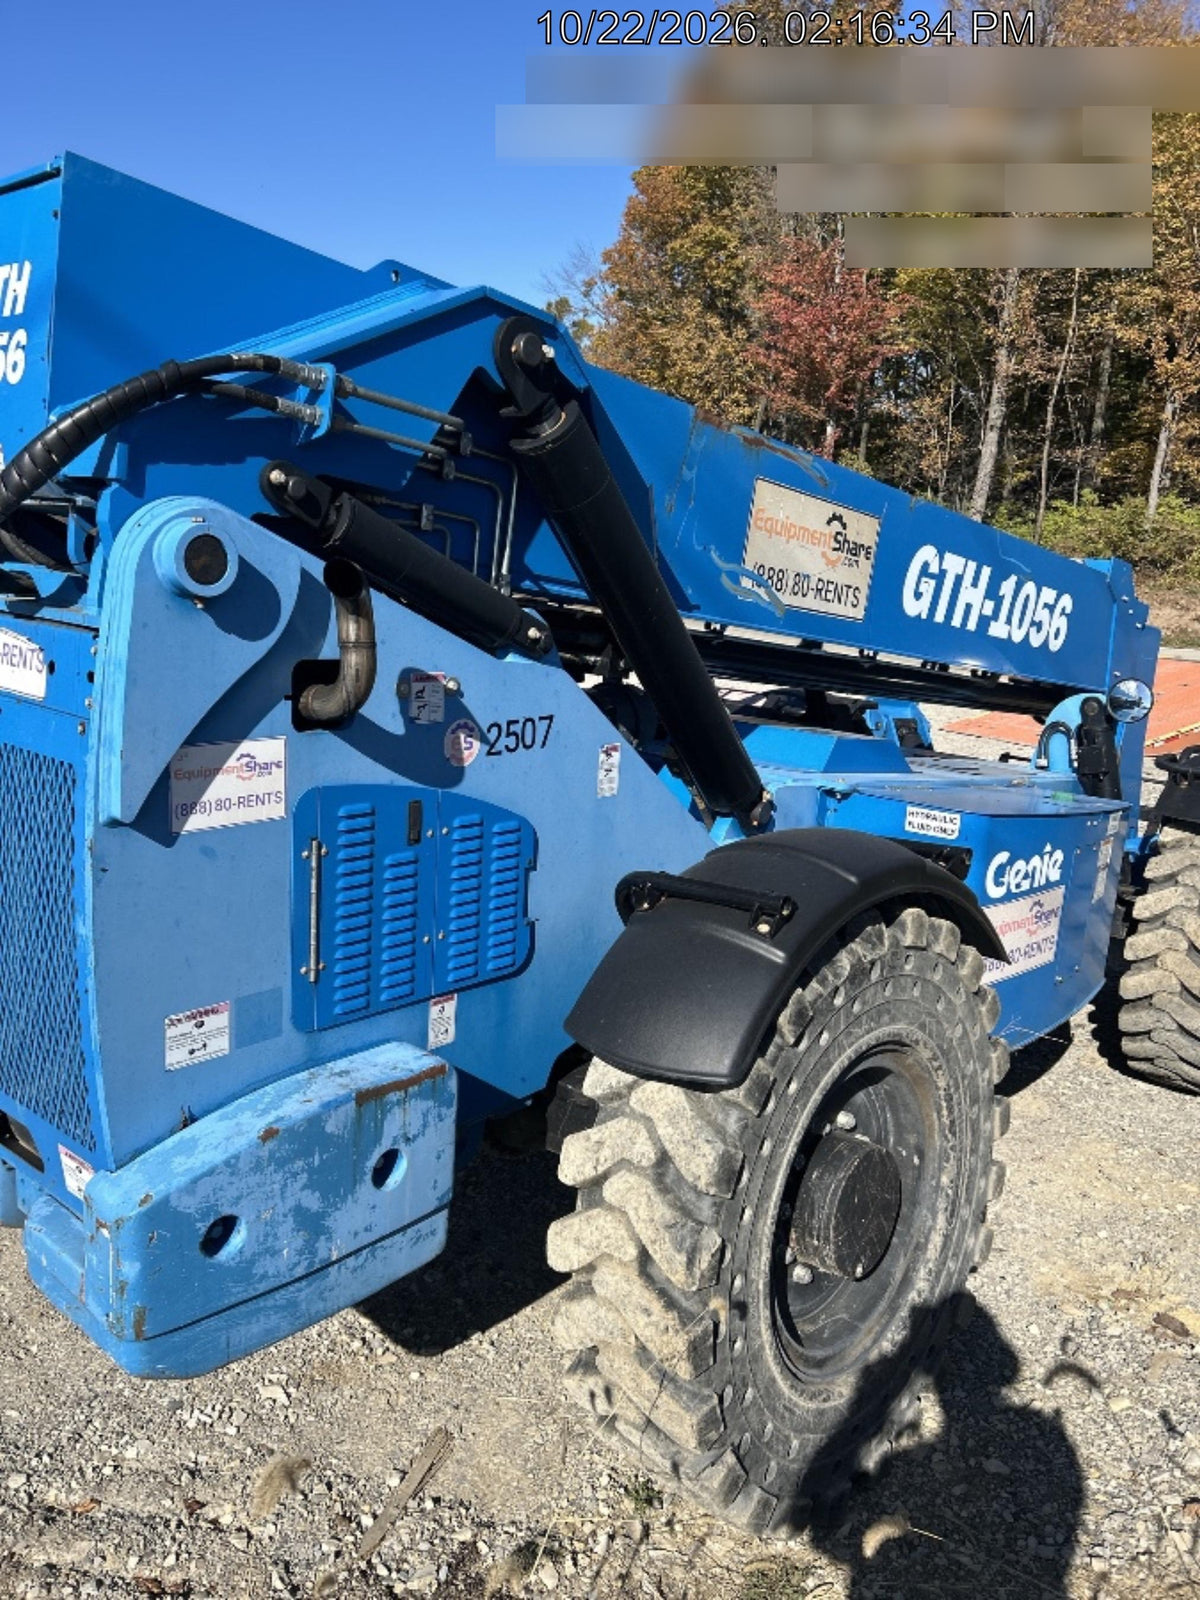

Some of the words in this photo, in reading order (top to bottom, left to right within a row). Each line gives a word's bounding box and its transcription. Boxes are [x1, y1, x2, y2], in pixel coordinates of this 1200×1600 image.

[792, 572, 862, 608] 80-RENTS
[902, 544, 1073, 652] GTH-1056
[486, 714, 554, 756] 2507
[174, 760, 283, 780] EquipmentShare
[174, 800, 212, 821] (888)
[214, 790, 283, 812] 80-RENTS
[985, 841, 1065, 899] Genie
